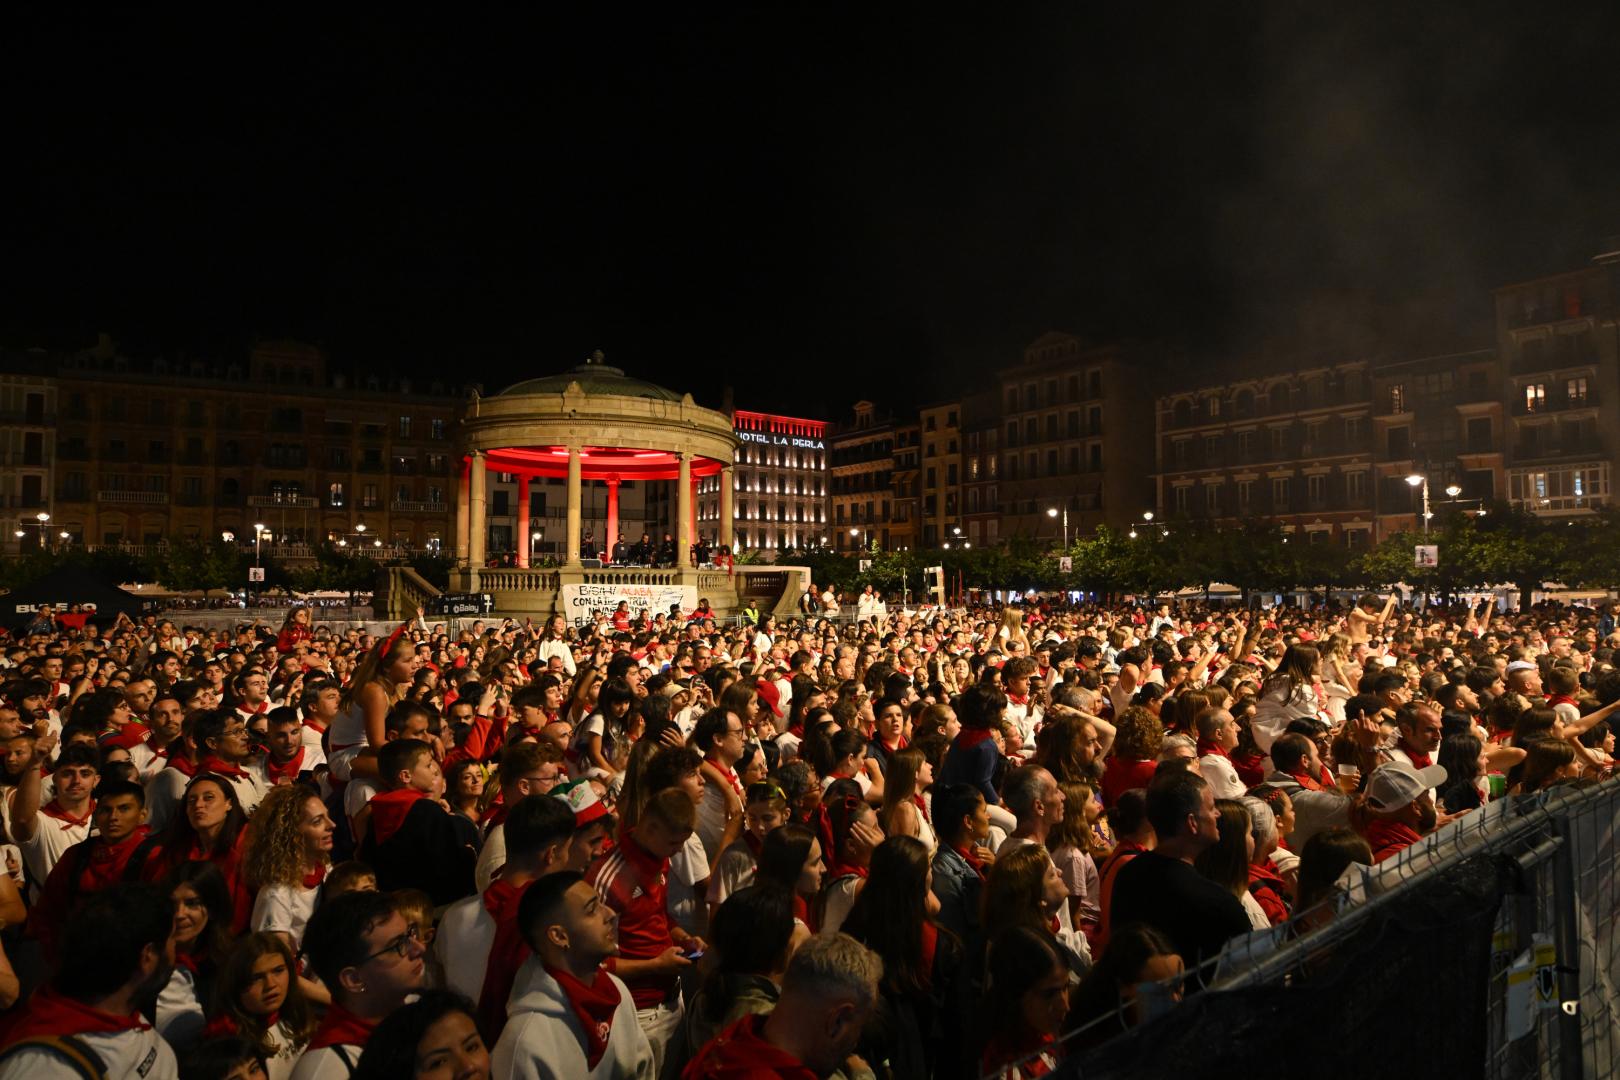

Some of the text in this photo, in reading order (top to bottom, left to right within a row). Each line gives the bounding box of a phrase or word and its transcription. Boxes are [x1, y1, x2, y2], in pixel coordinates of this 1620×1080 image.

[773, 436, 788, 445] LA
[792, 438, 824, 449] PERLA
[621, 587, 653, 596] ACABA
[573, 598, 591, 606] CON
[593, 597, 602, 606] LA
[15, 602, 97, 613] BUEO
